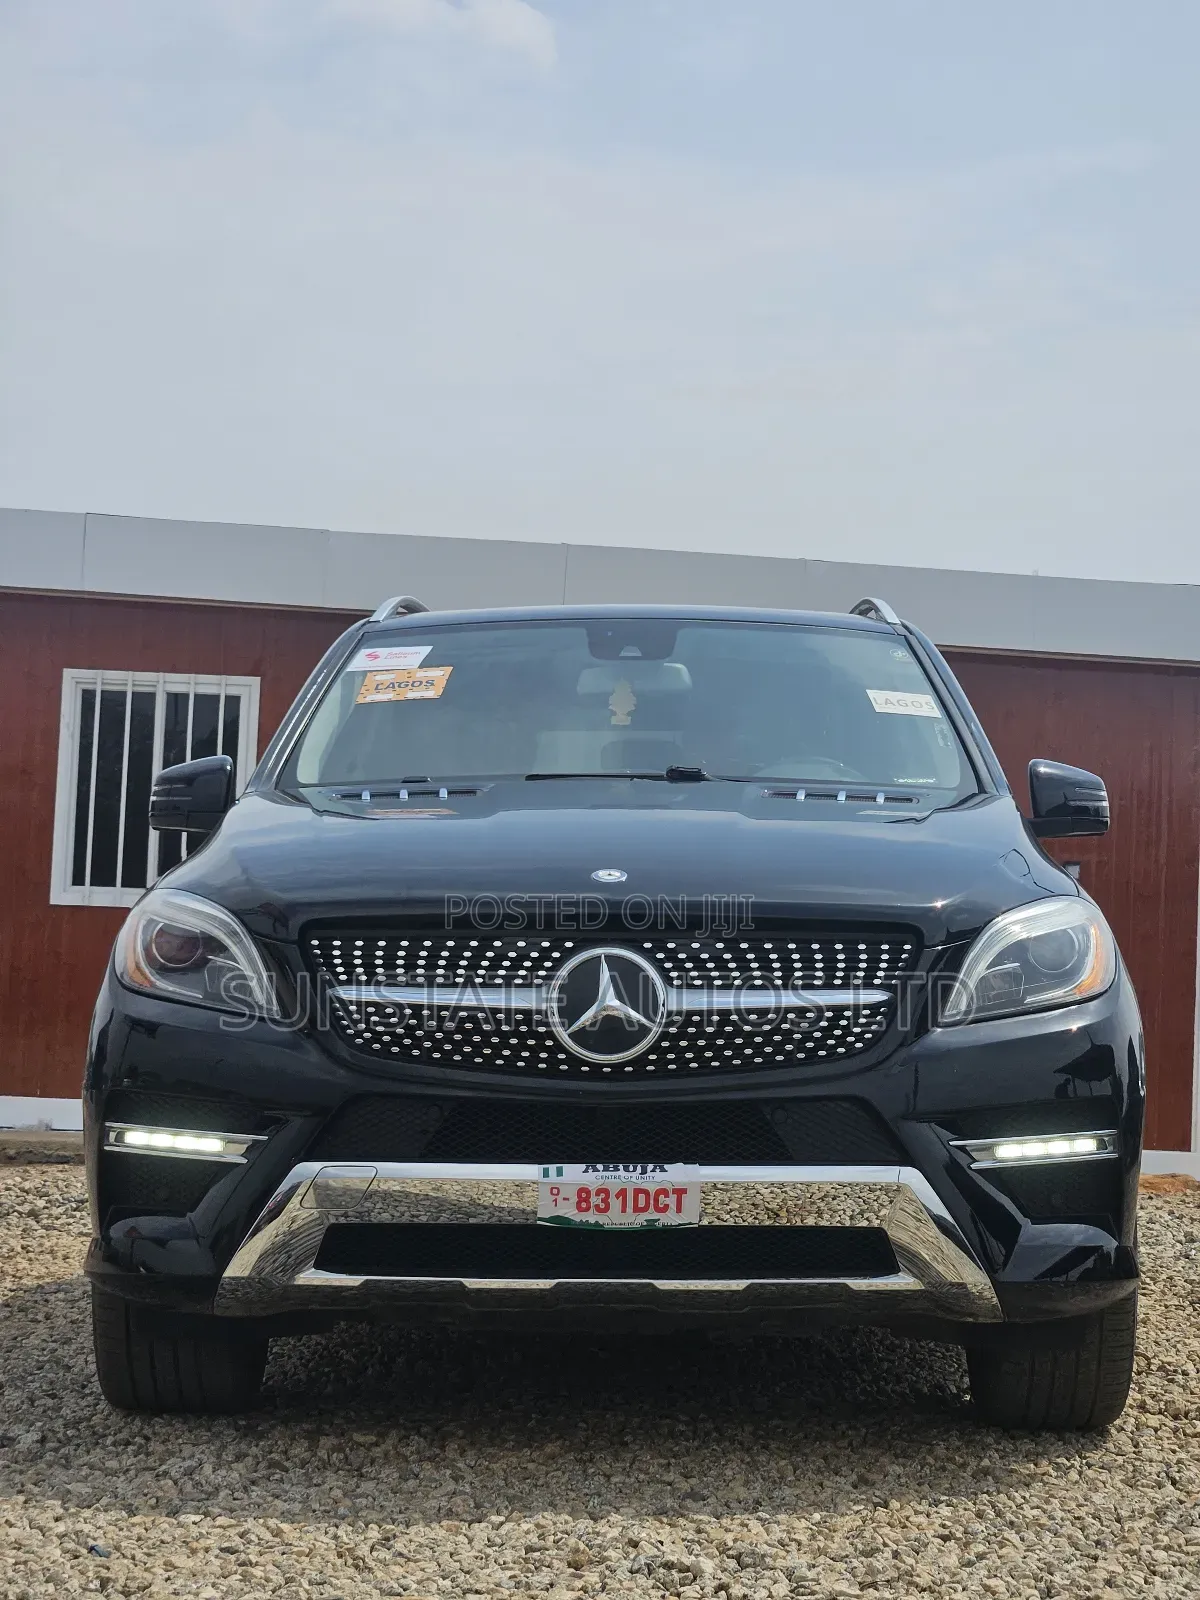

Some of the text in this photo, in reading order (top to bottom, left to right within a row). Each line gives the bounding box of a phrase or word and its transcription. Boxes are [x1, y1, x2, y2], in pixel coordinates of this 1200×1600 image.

[374, 679, 436, 691] LAGOS
[872, 696, 936, 710] LAGOS
[582, 1164, 668, 1175] ABUJA
